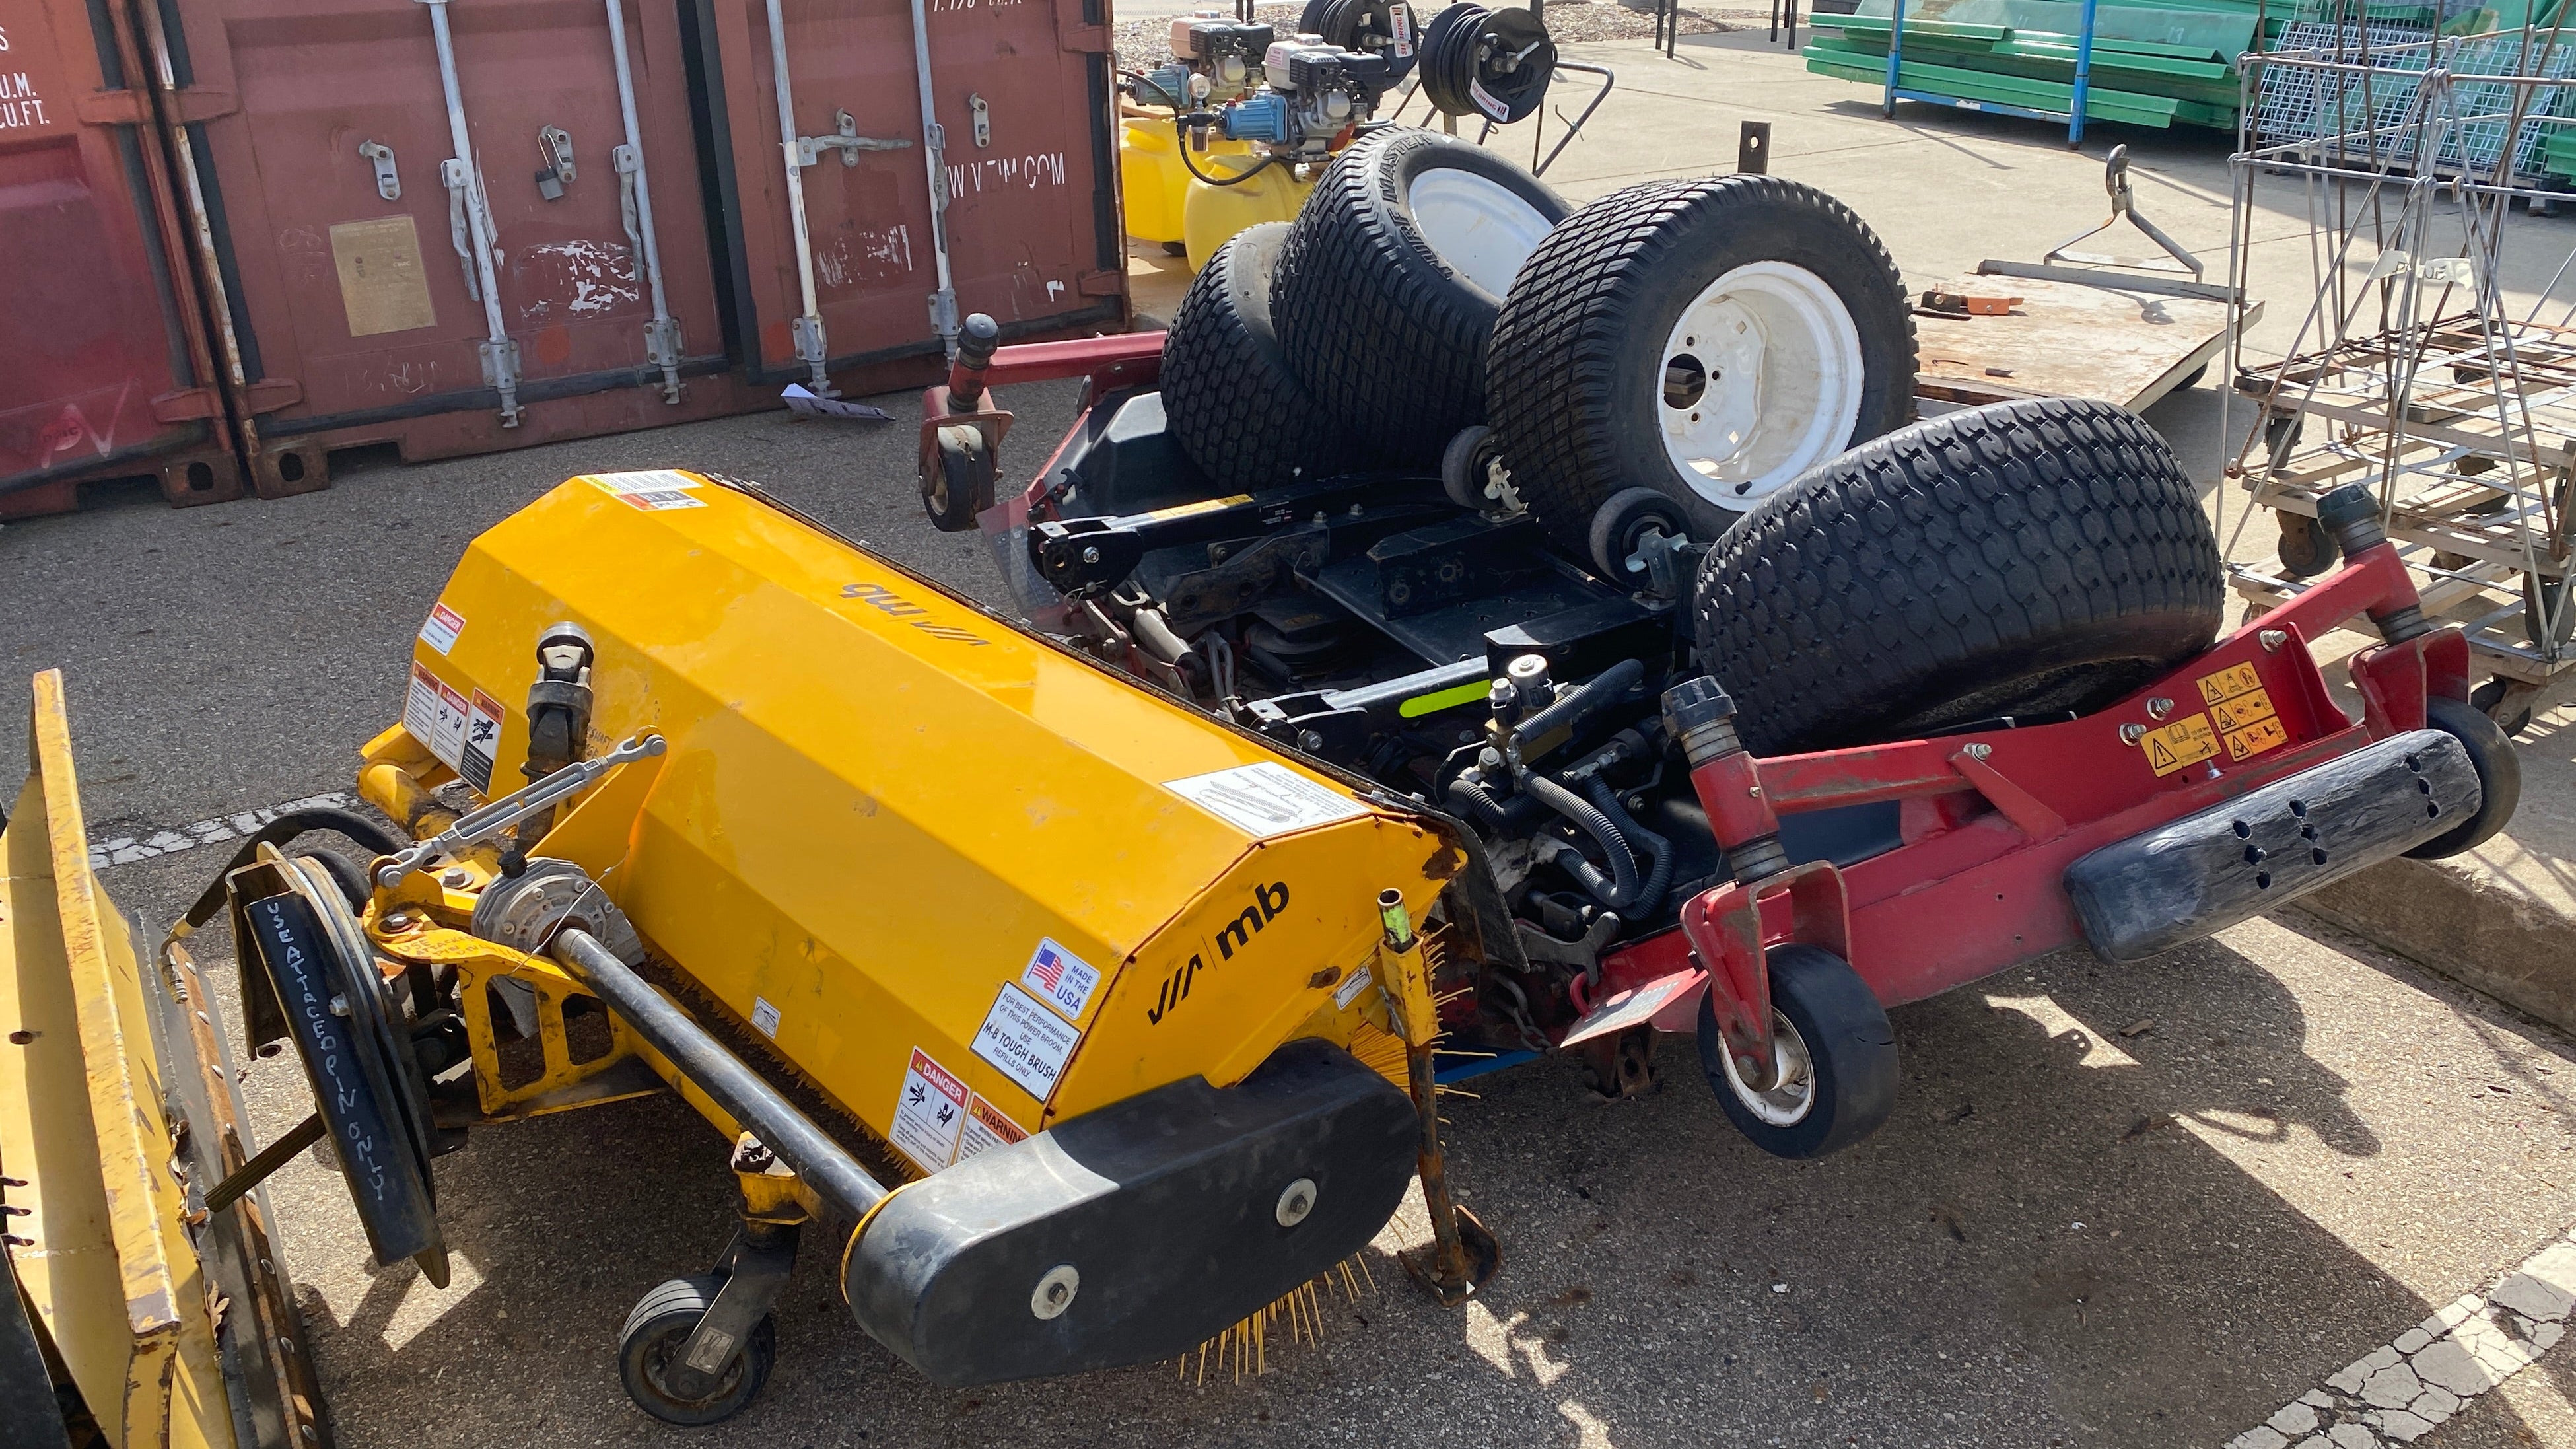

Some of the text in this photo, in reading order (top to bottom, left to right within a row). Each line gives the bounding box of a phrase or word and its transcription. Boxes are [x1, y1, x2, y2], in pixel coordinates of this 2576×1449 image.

[1379, 133, 1453, 280] TURF MASTER
[439, 611, 462, 631] DANGER
[446, 691, 466, 716] DANGER
[1215, 881, 1290, 962] mb
[398, 939, 430, 952] USE
[1064, 973, 1089, 995] IN THE
[1071, 966, 1093, 984] MADE
[1057, 985, 1081, 1012] USA
[998, 1003, 1009, 1014] OF
[1006, 1009, 1022, 1024] THIS
[1019, 1018, 1041, 1038] POWER
[1002, 992, 1016, 1006] FOR
[1014, 1001, 1030, 1016] BEST
[1028, 1010, 1072, 1045] PERFORMANCE
[267, 902, 294, 943] USE
[325, 1055, 356, 1114] PIN
[348, 1122, 385, 1201] ONLY
[982, 1020, 1057, 1082] M-B TOUGH BRUSH
[1018, 1032, 1033, 1045] USE
[992, 1046, 1016, 1068] REFILLS
[922, 1063, 963, 1103] DANGER
[982, 1107, 1026, 1143] WARNIN
